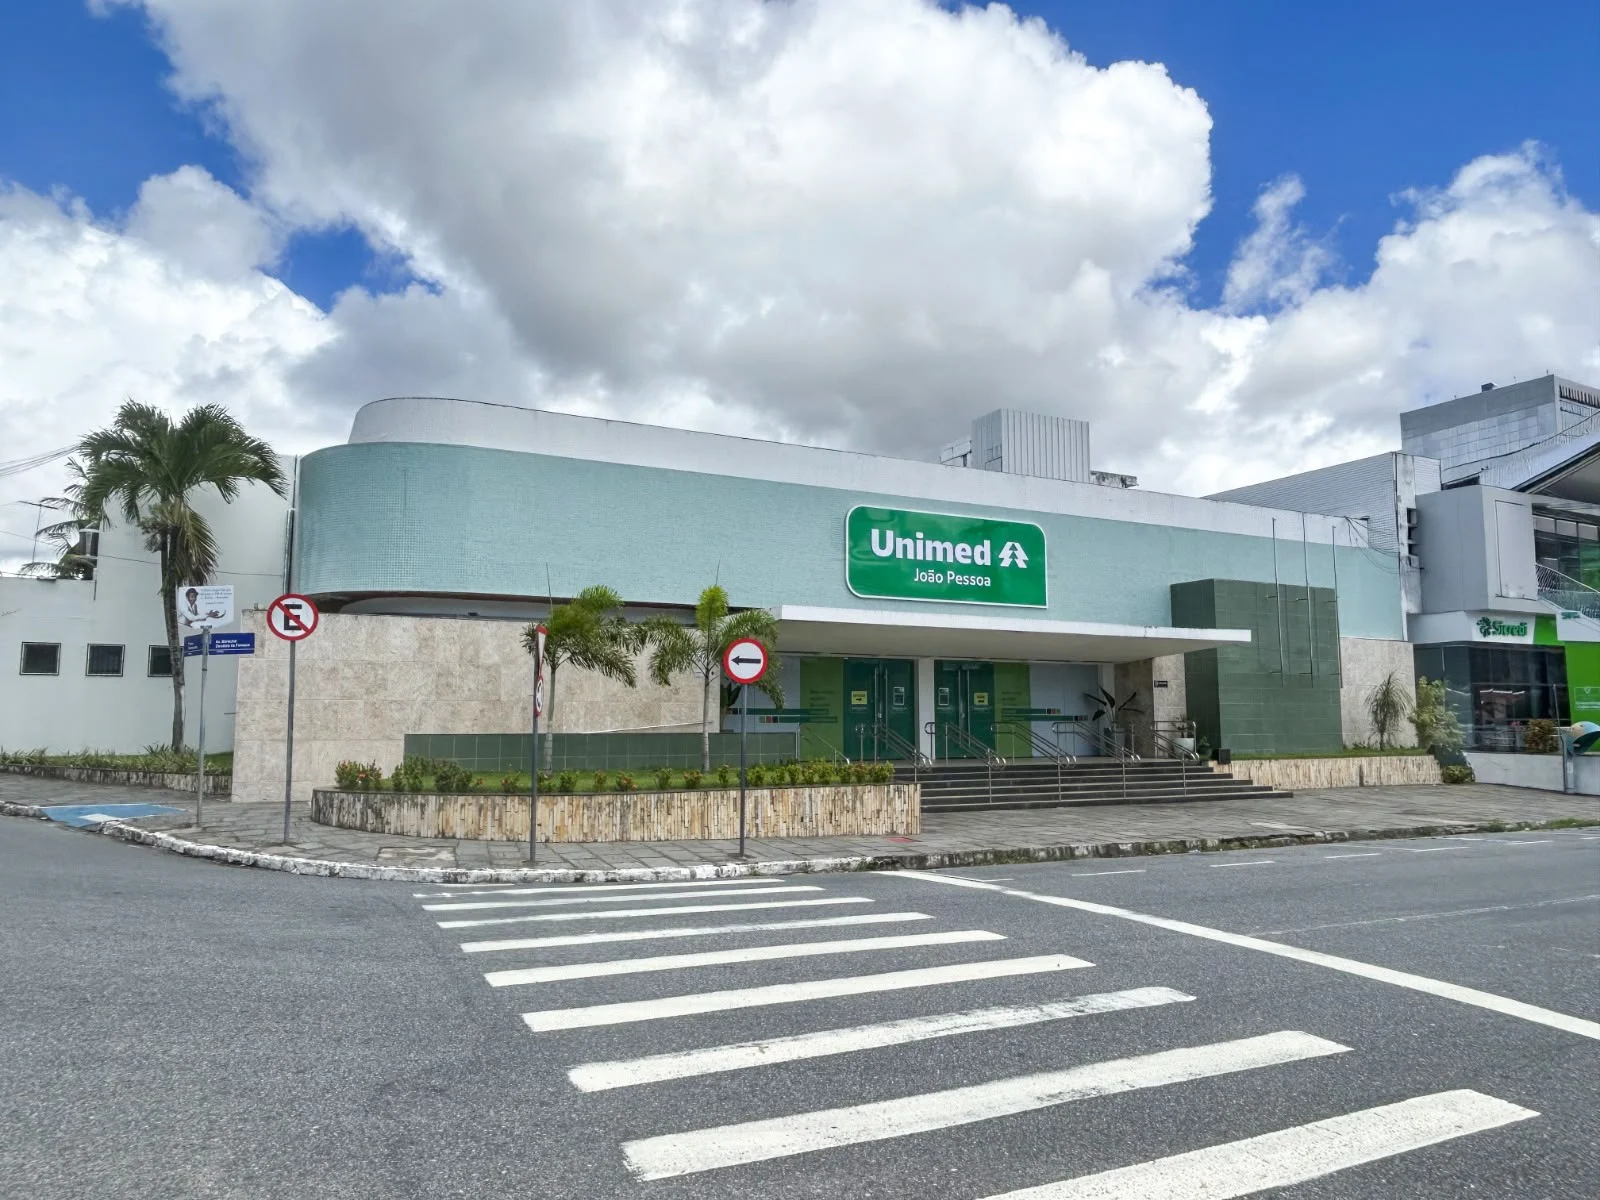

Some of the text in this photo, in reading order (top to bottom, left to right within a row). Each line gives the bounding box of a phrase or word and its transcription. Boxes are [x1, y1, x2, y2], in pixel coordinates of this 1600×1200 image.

[871, 528, 991, 566] Unimed
[914, 567, 991, 587] João Pessoa
[1491, 620, 1528, 637] Sicredi
